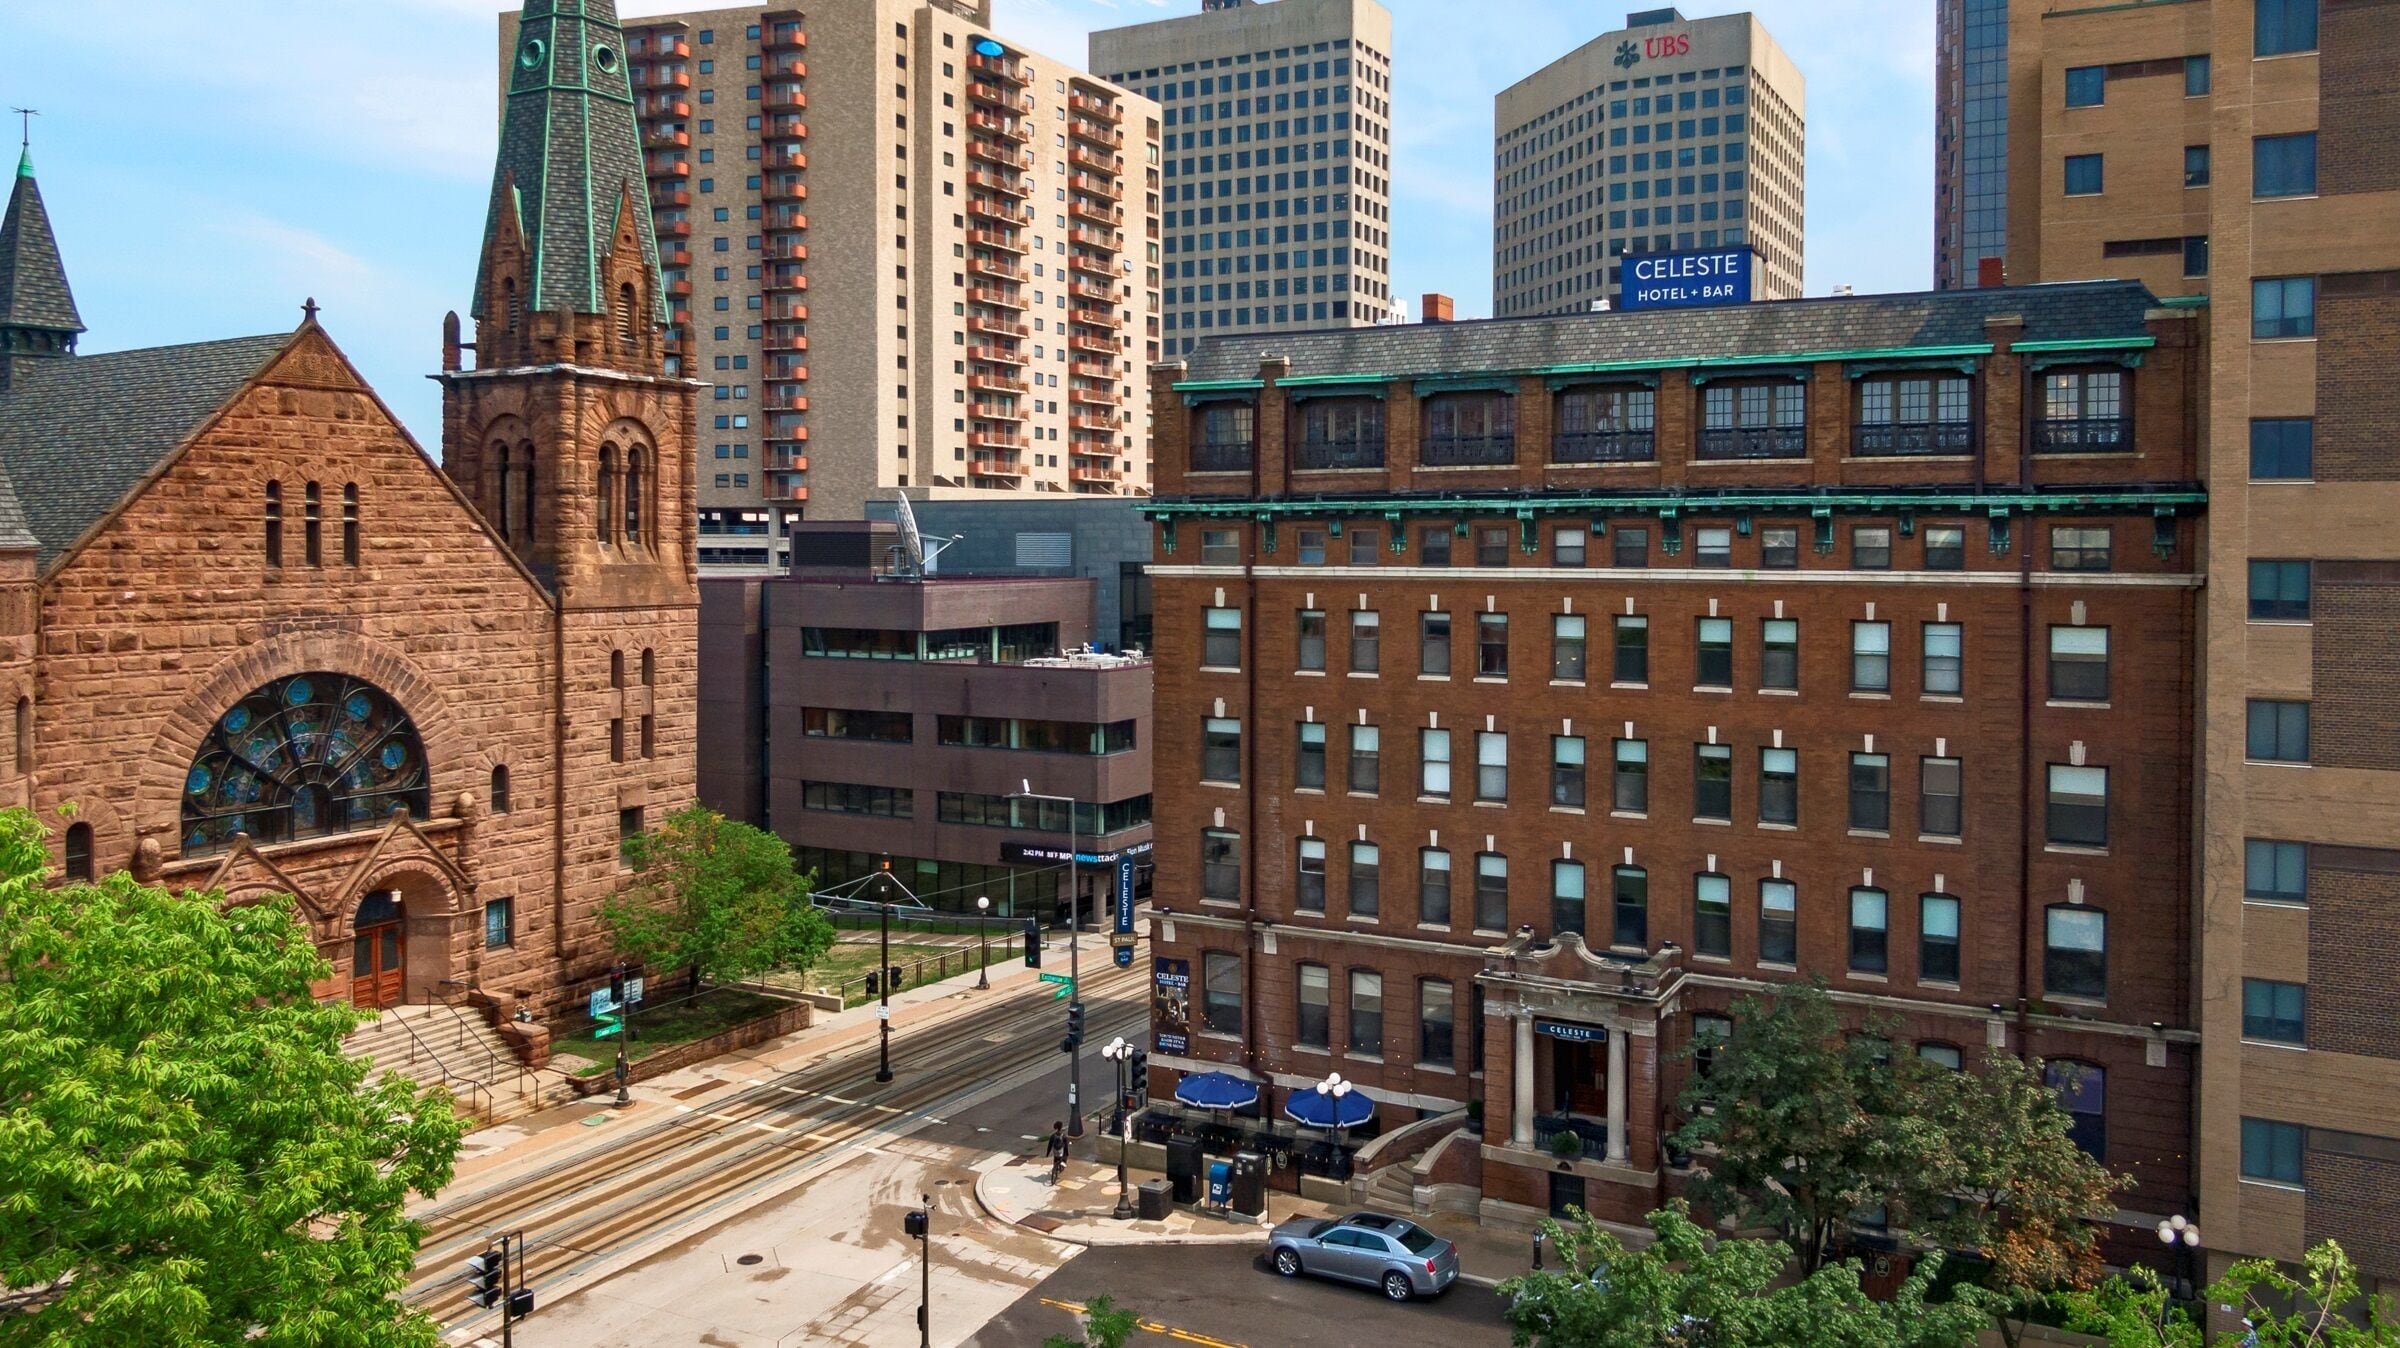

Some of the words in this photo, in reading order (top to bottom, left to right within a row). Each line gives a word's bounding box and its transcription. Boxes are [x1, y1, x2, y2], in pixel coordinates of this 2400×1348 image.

[1645, 34, 1689, 59] UBS
[1635, 254, 1738, 280] CELESTE
[1638, 287, 1687, 302] HOTEL
[1691, 289, 1698, 297] +
[1703, 285, 1733, 298] BAR
[1122, 863, 1130, 926] CELESTE
[1156, 972, 1189, 983] CELESTE
[1550, 1025, 1590, 1037] CELESTE
